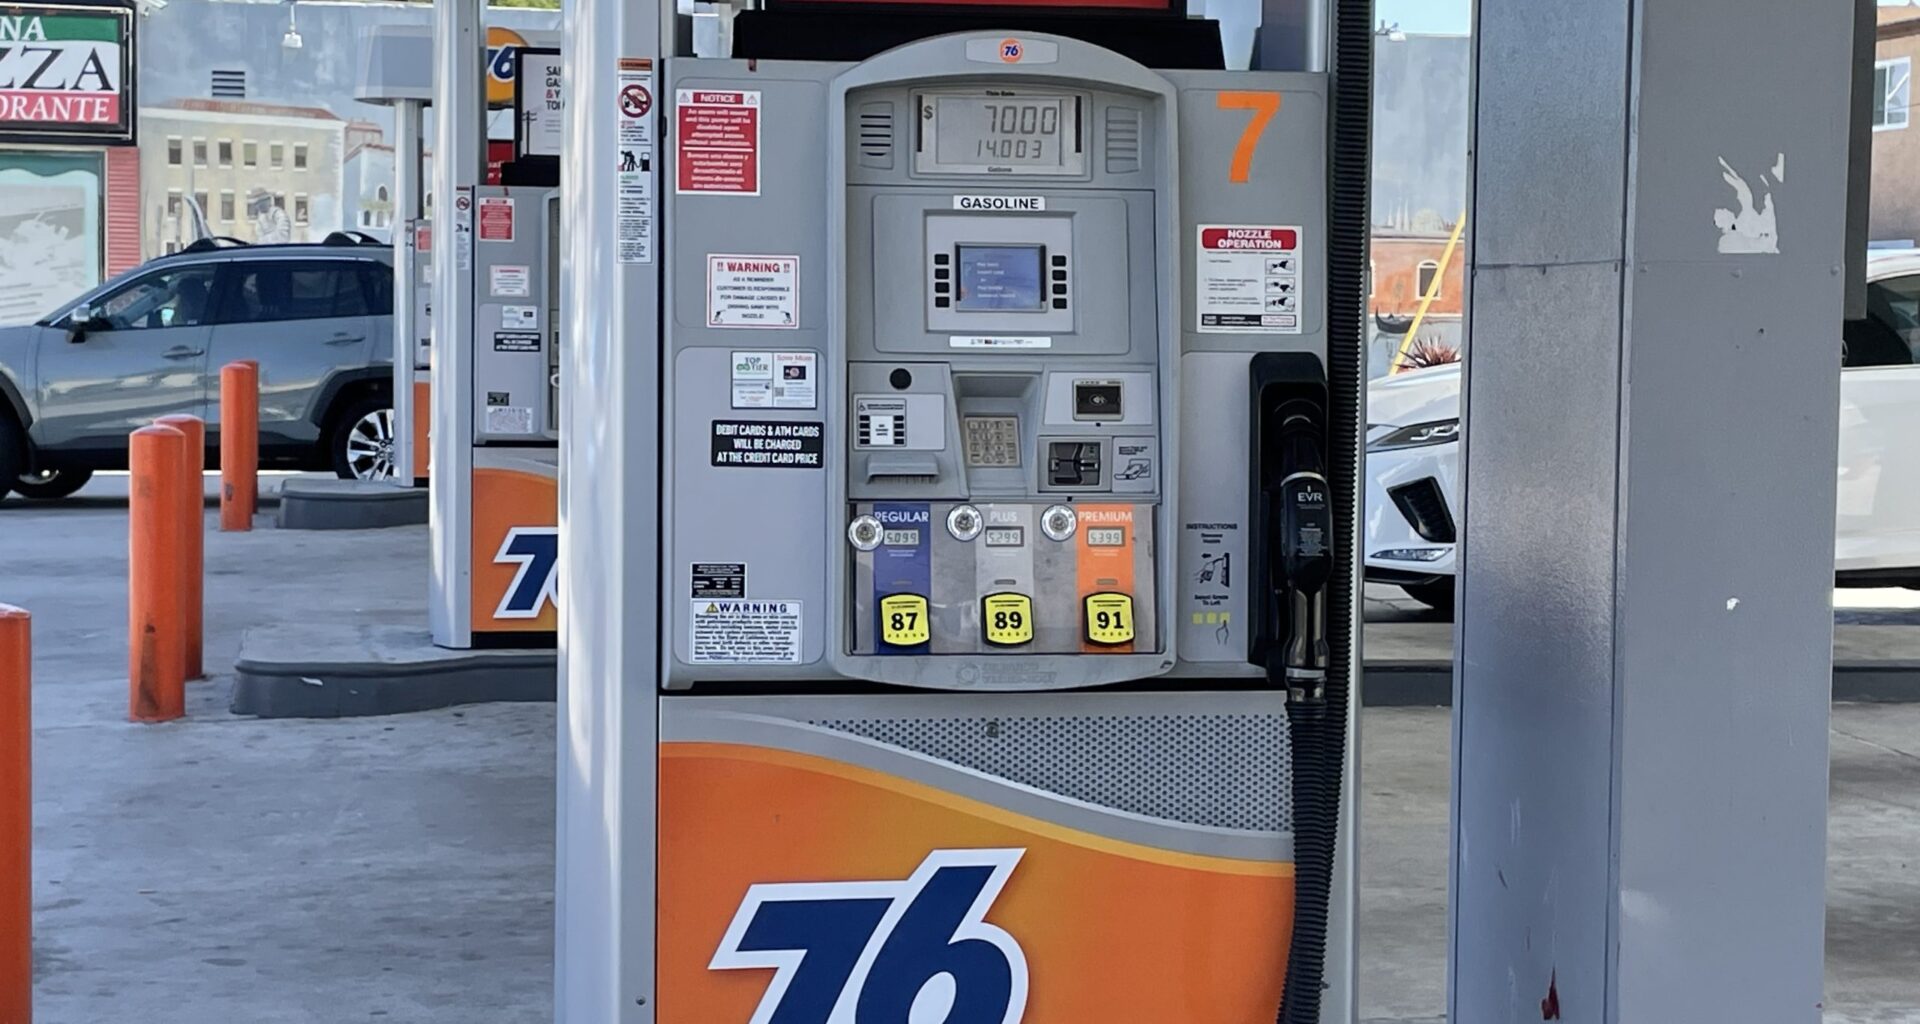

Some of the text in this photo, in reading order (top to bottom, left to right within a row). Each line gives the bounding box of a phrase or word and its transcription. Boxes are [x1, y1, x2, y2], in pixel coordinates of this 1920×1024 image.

[1004, 44, 1019, 56] 76
[700, 94, 736, 103] NOTICE
[923, 105, 1057, 135] $ 70.00
[1216, 90, 1281, 184] 7
[977, 139, 1042, 158] 14.003
[960, 197, 1039, 210] GASOLINE
[1227, 229, 1272, 239] NOZZLE
[1217, 238, 1282, 249] OPERATION
[727, 262, 781, 273] WARNING
[716, 424, 820, 437] DEBIT CARDS & ATM CARDS
[733, 439, 802, 450] WILL BE CHARGED
[717, 452, 818, 464] AT THE CREDIT CARD PRICE
[1298, 492, 1323, 502] EVR
[990, 511, 1017, 522] PLUS
[1078, 511, 1132, 522] PREMIUM
[493, 527, 558, 618] 7
[719, 603, 787, 613] WARNING
[891, 612, 918, 631] 87
[995, 611, 1022, 630] 89
[1096, 611, 1124, 630] 91
[707, 847, 1029, 1024] 76
